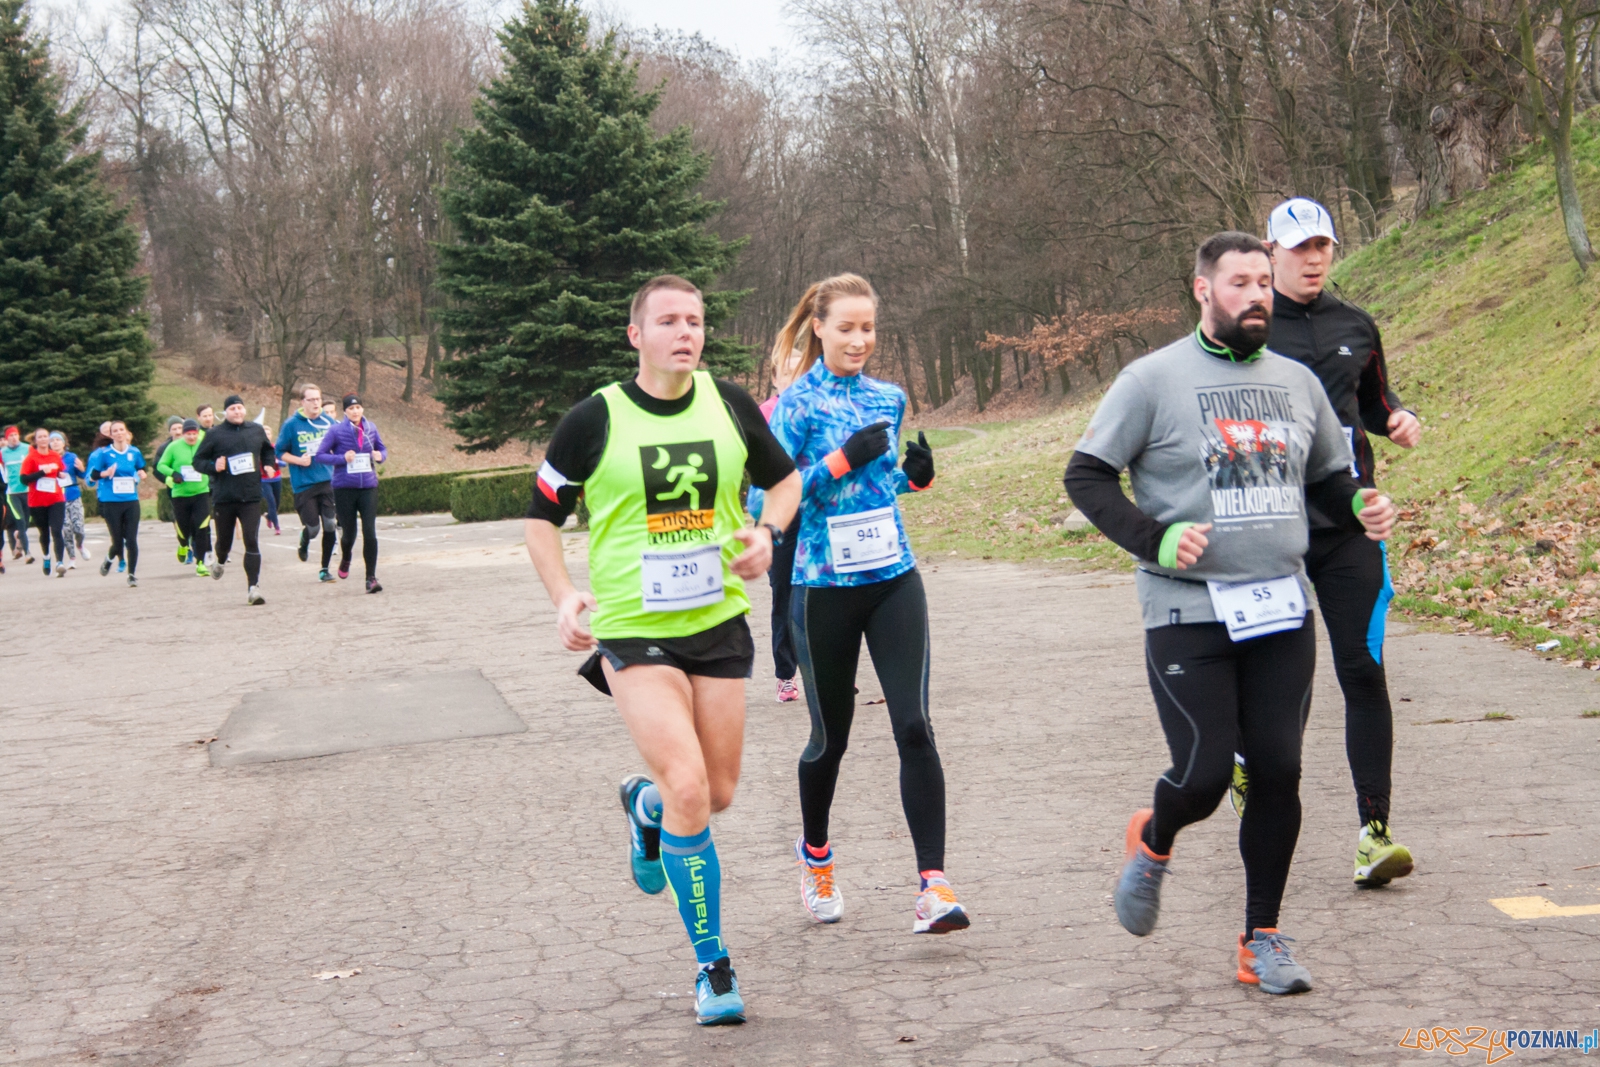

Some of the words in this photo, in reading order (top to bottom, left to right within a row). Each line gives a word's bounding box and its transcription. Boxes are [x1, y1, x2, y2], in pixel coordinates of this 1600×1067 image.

[1197, 388, 1296, 425] POWSTANIE
[662, 510, 705, 530] night
[648, 527, 717, 545] runners
[857, 527, 881, 542] 941
[672, 562, 698, 577] 220
[1252, 586, 1272, 602] 55
